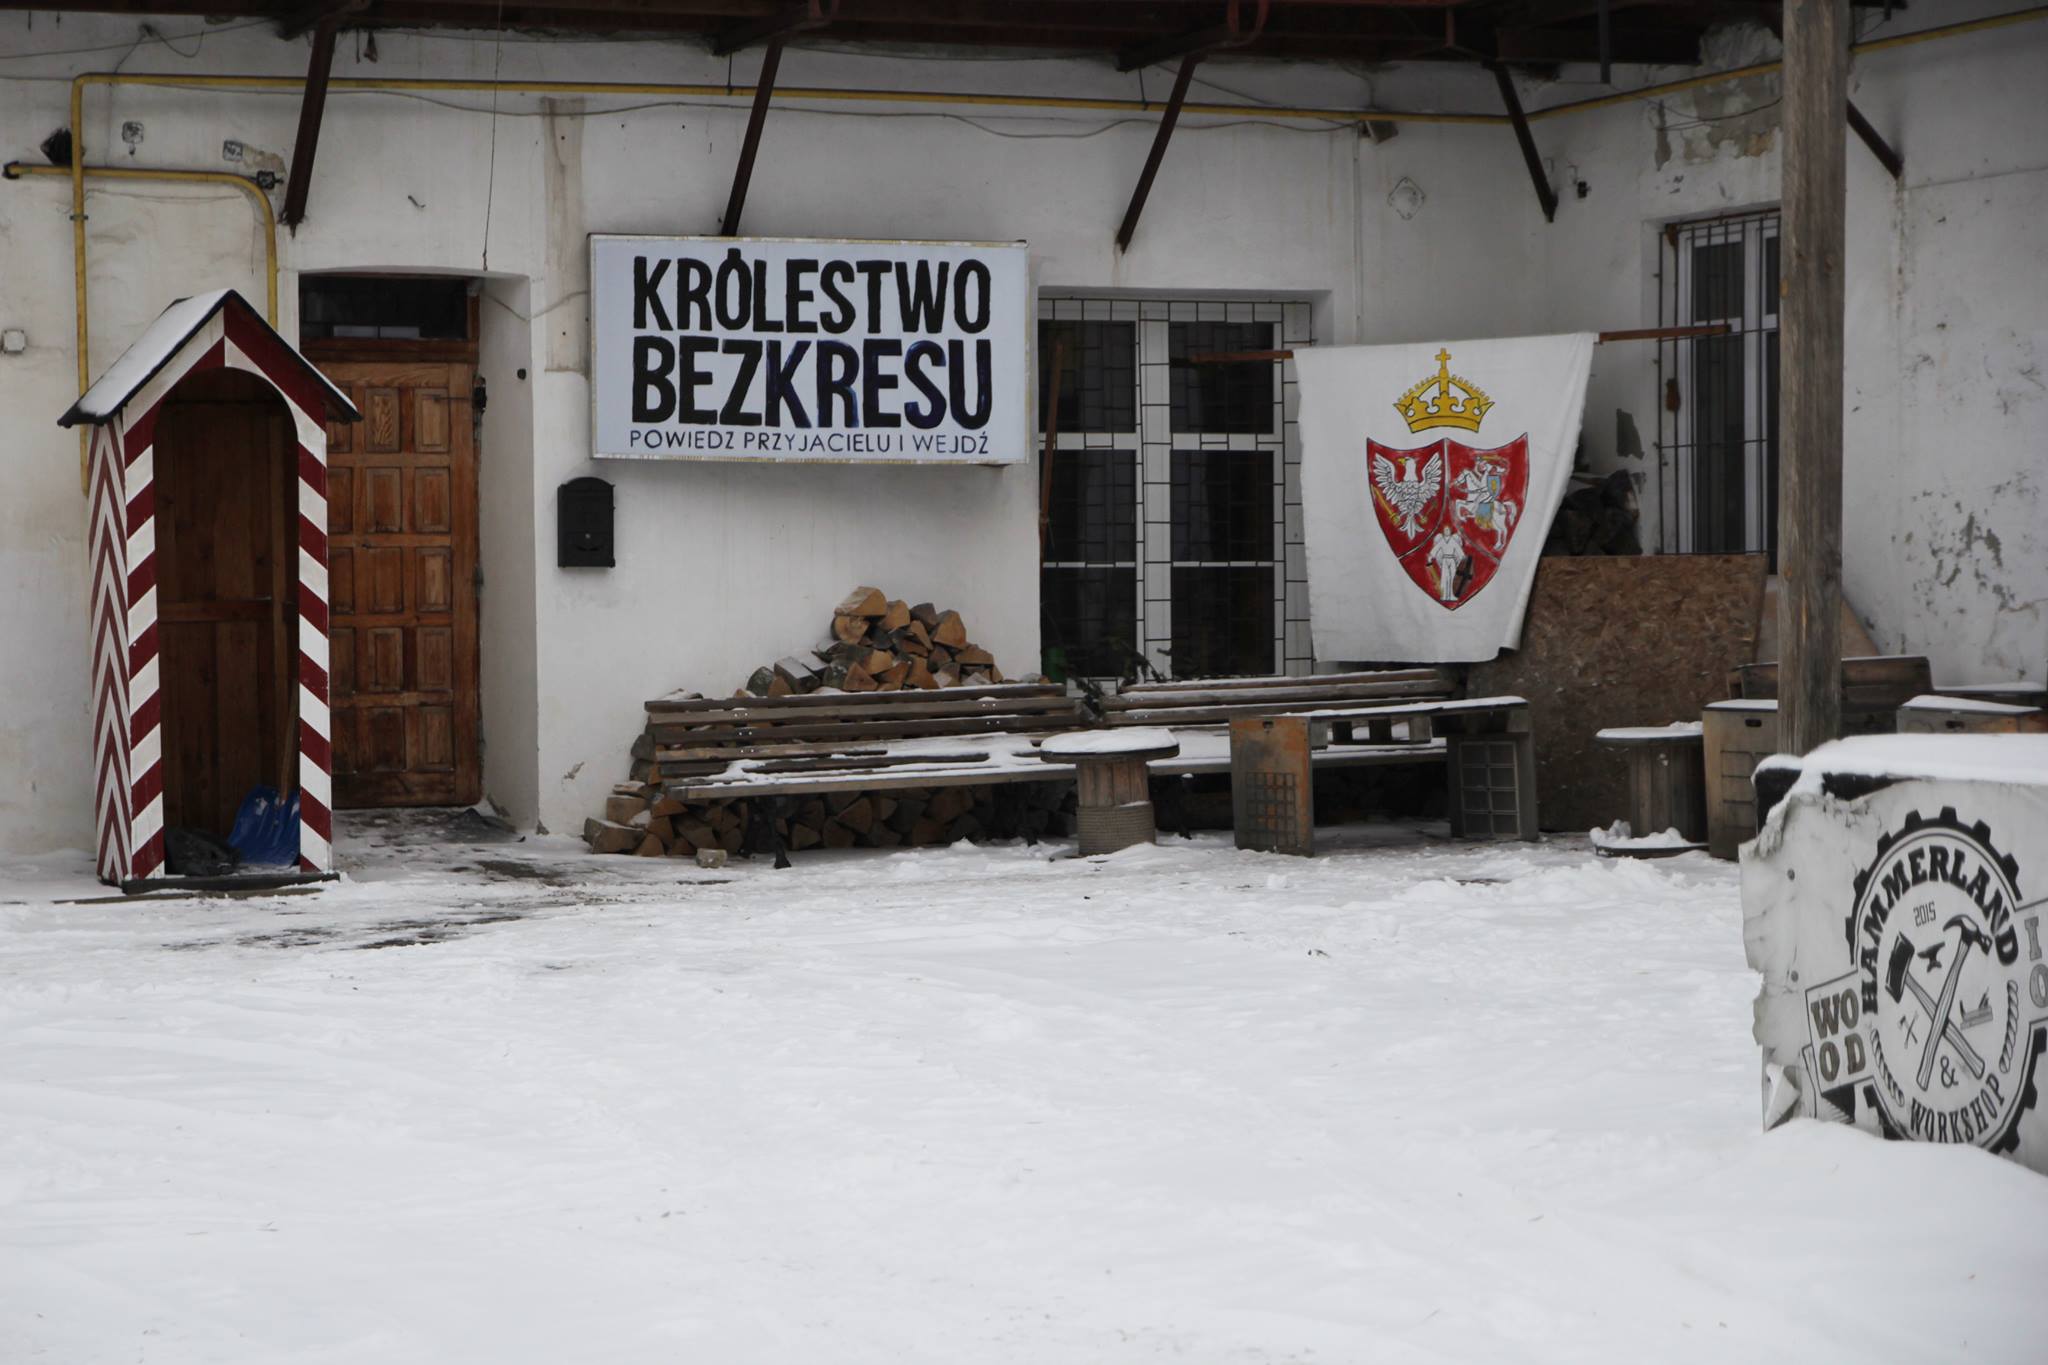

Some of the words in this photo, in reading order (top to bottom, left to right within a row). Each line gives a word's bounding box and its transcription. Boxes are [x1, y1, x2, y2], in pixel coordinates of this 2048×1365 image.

[633, 248, 991, 334] KRÓLESTWO
[632, 335, 992, 430] BEZKRESU
[630, 430, 735, 450] POWIEDZ
[743, 432, 890, 453] PRZYJACIELU
[899, 434, 904, 452] I
[912, 431, 989, 455] WEJDŹ
[1861, 845, 2019, 1016] HAMMERLAND
[1913, 902, 1937, 928] 2015
[1939, 1055, 1959, 1088] &
[1910, 1073, 2004, 1144] WORKSHOP
